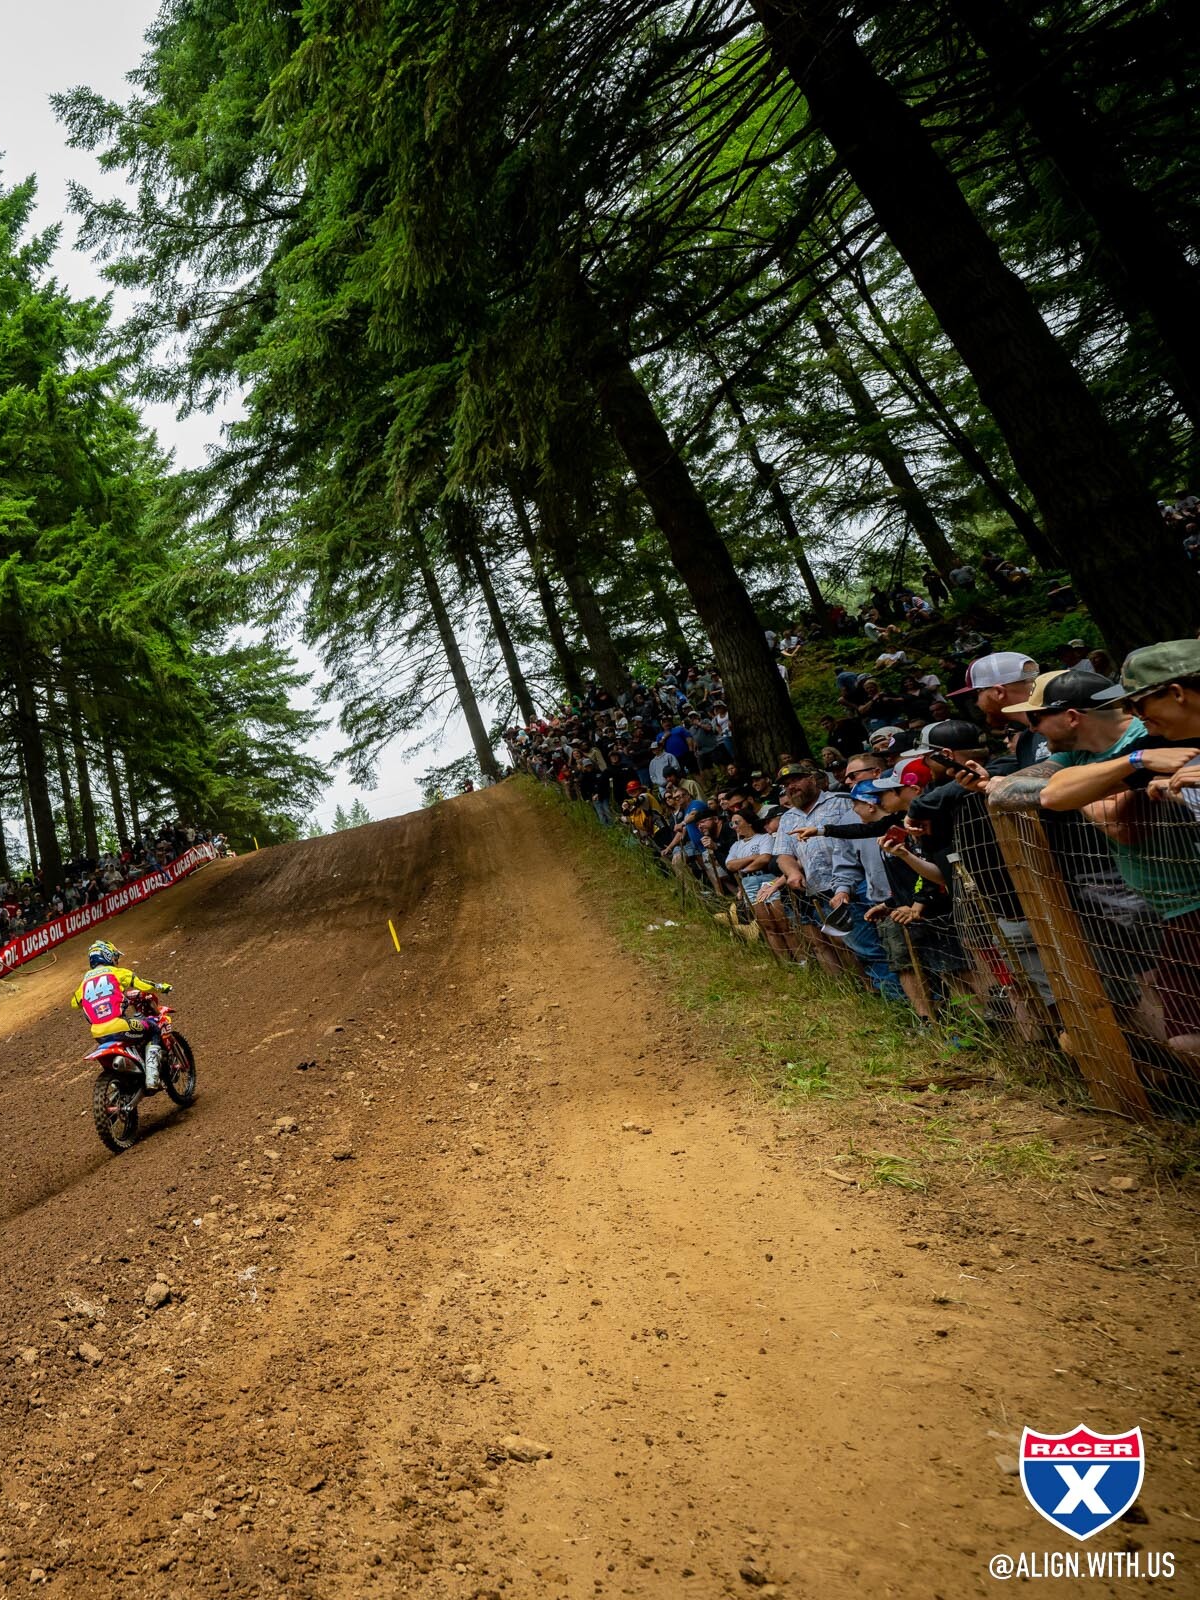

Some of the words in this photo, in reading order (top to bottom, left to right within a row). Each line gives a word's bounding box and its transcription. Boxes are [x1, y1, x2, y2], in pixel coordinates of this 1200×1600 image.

[142, 874, 163, 893] LUCAS
[105, 892, 129, 914] LUCAS
[129, 884, 142, 901] OIL
[65, 909, 91, 934] LUCAS
[91, 903, 104, 921] OIL
[21, 929, 49, 957] LUCAS
[49, 922, 64, 942] OIL
[84, 975, 114, 1003] 44
